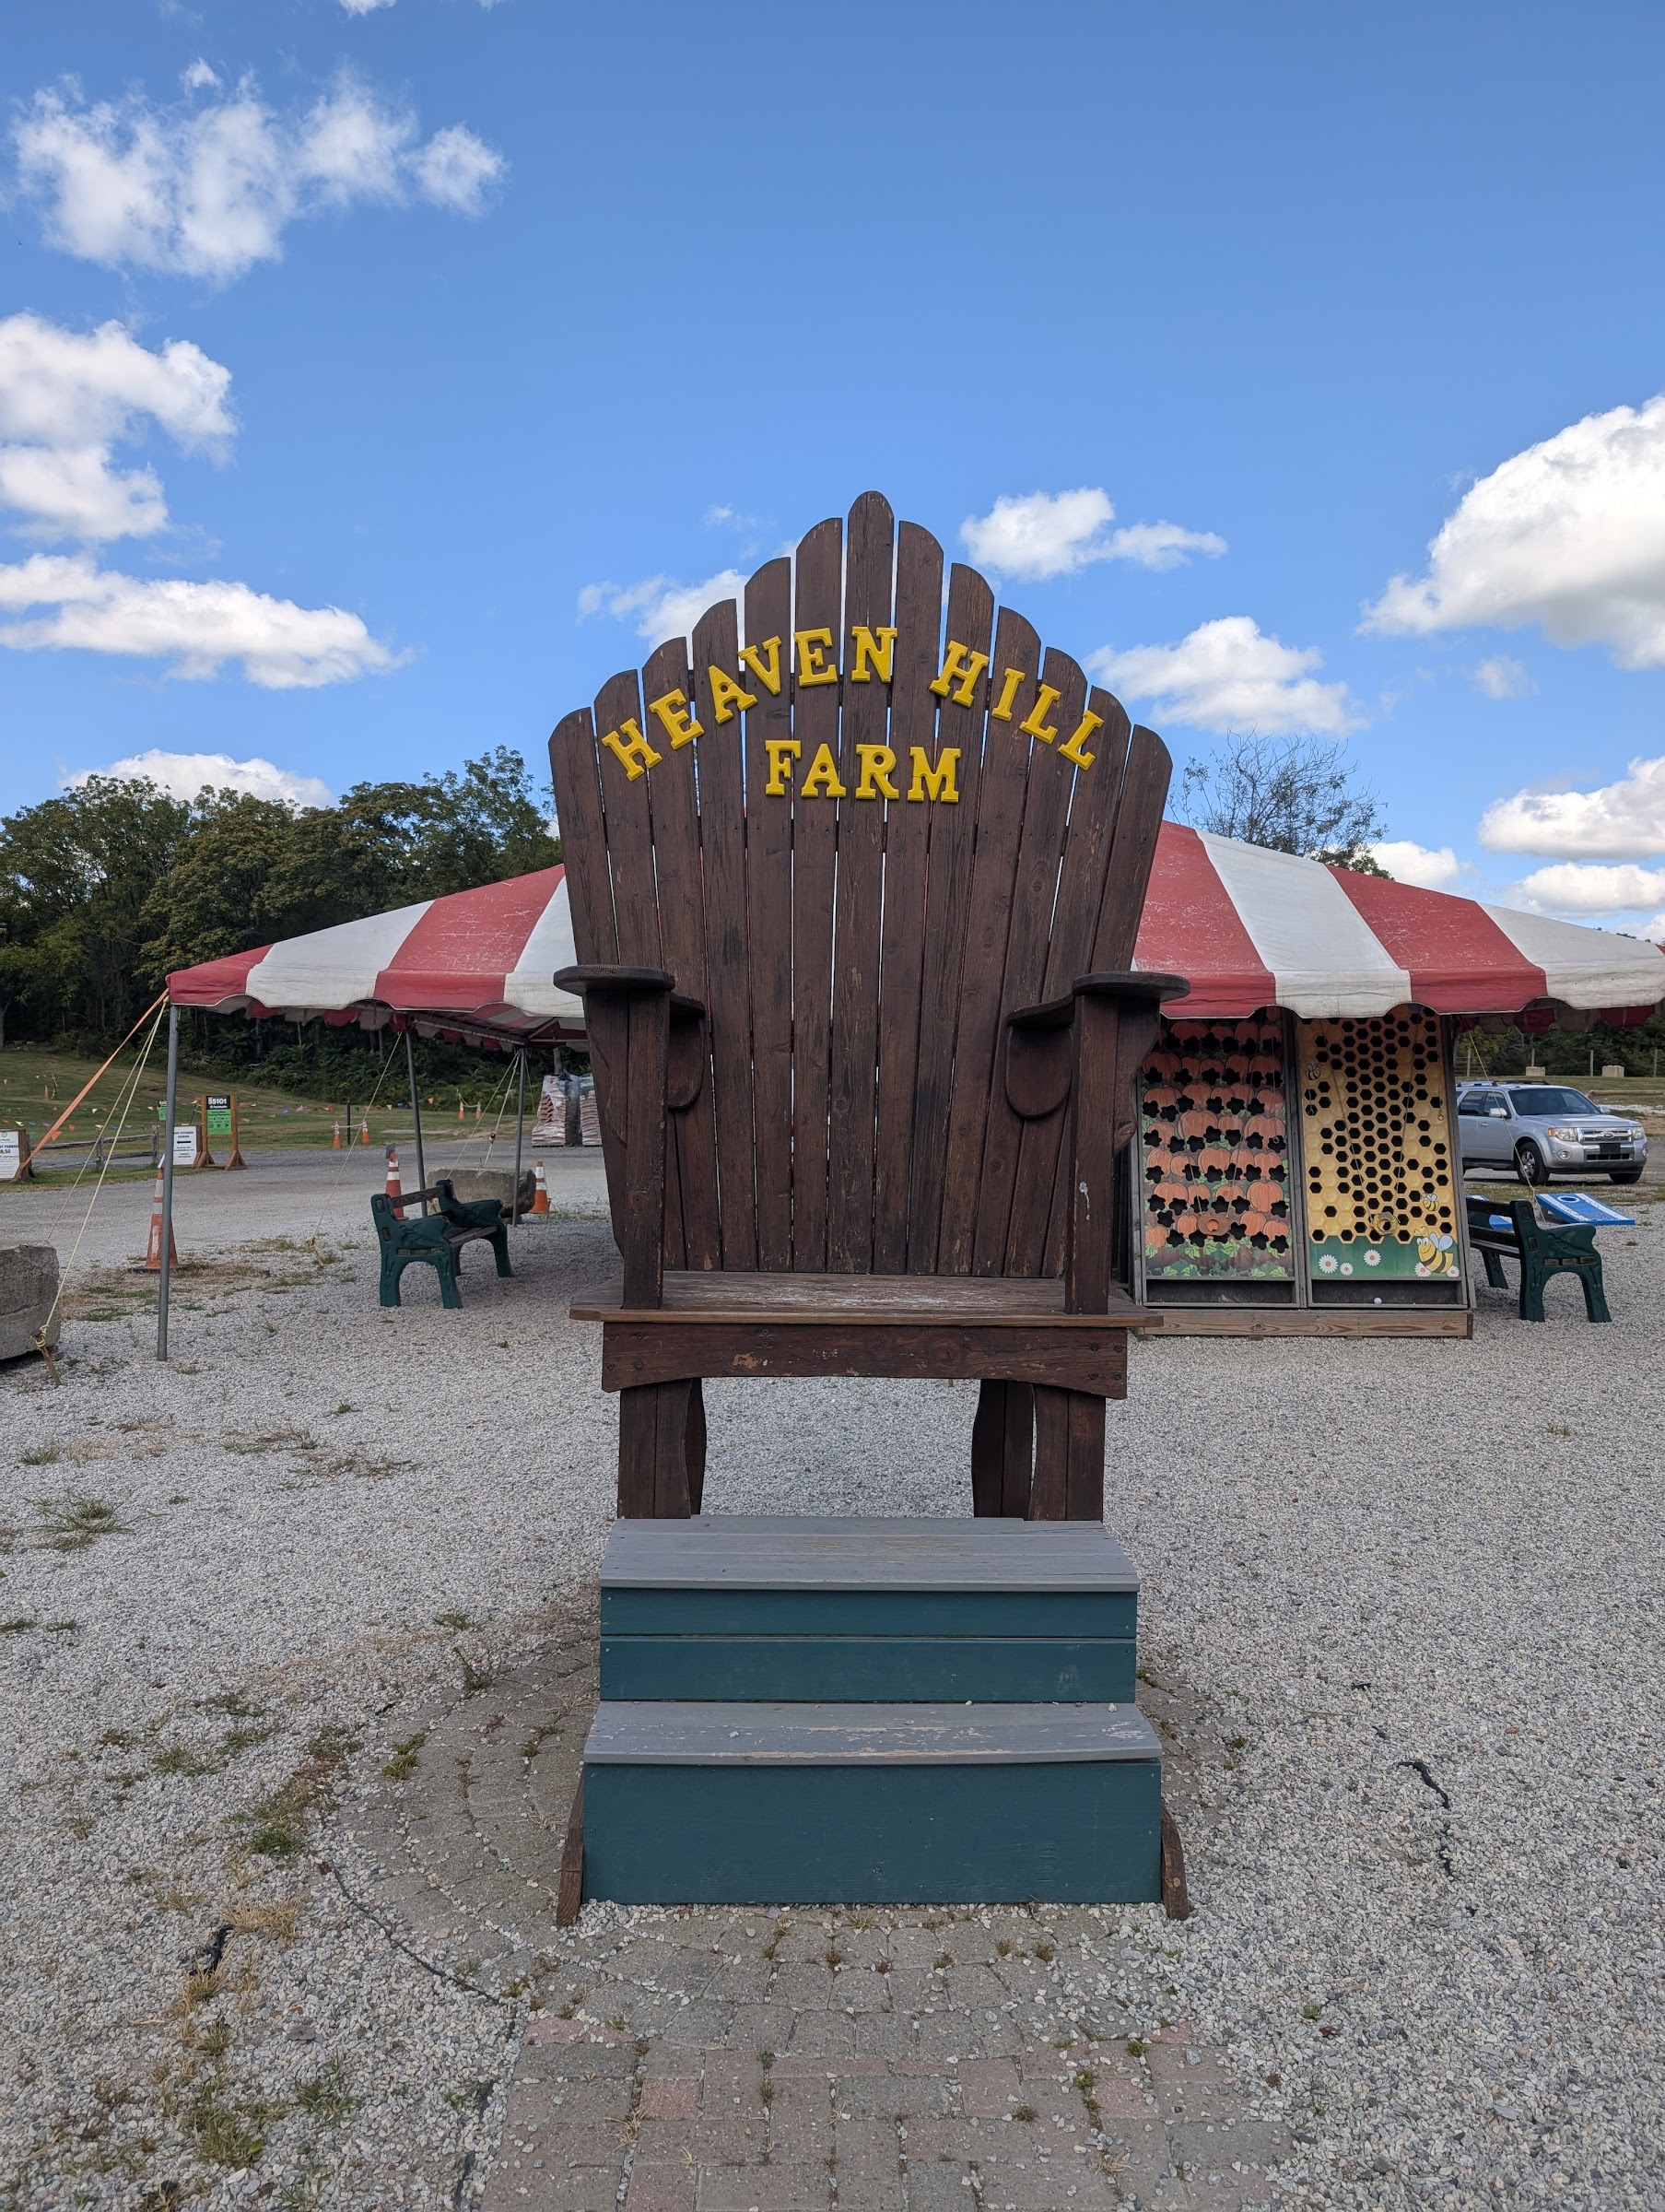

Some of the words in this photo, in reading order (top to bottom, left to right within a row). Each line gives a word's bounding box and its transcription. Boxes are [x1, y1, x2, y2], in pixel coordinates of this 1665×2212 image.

[601, 626, 898, 782] HEAVEN
[929, 641, 1104, 771] HILL
[765, 739, 961, 804] FARM
